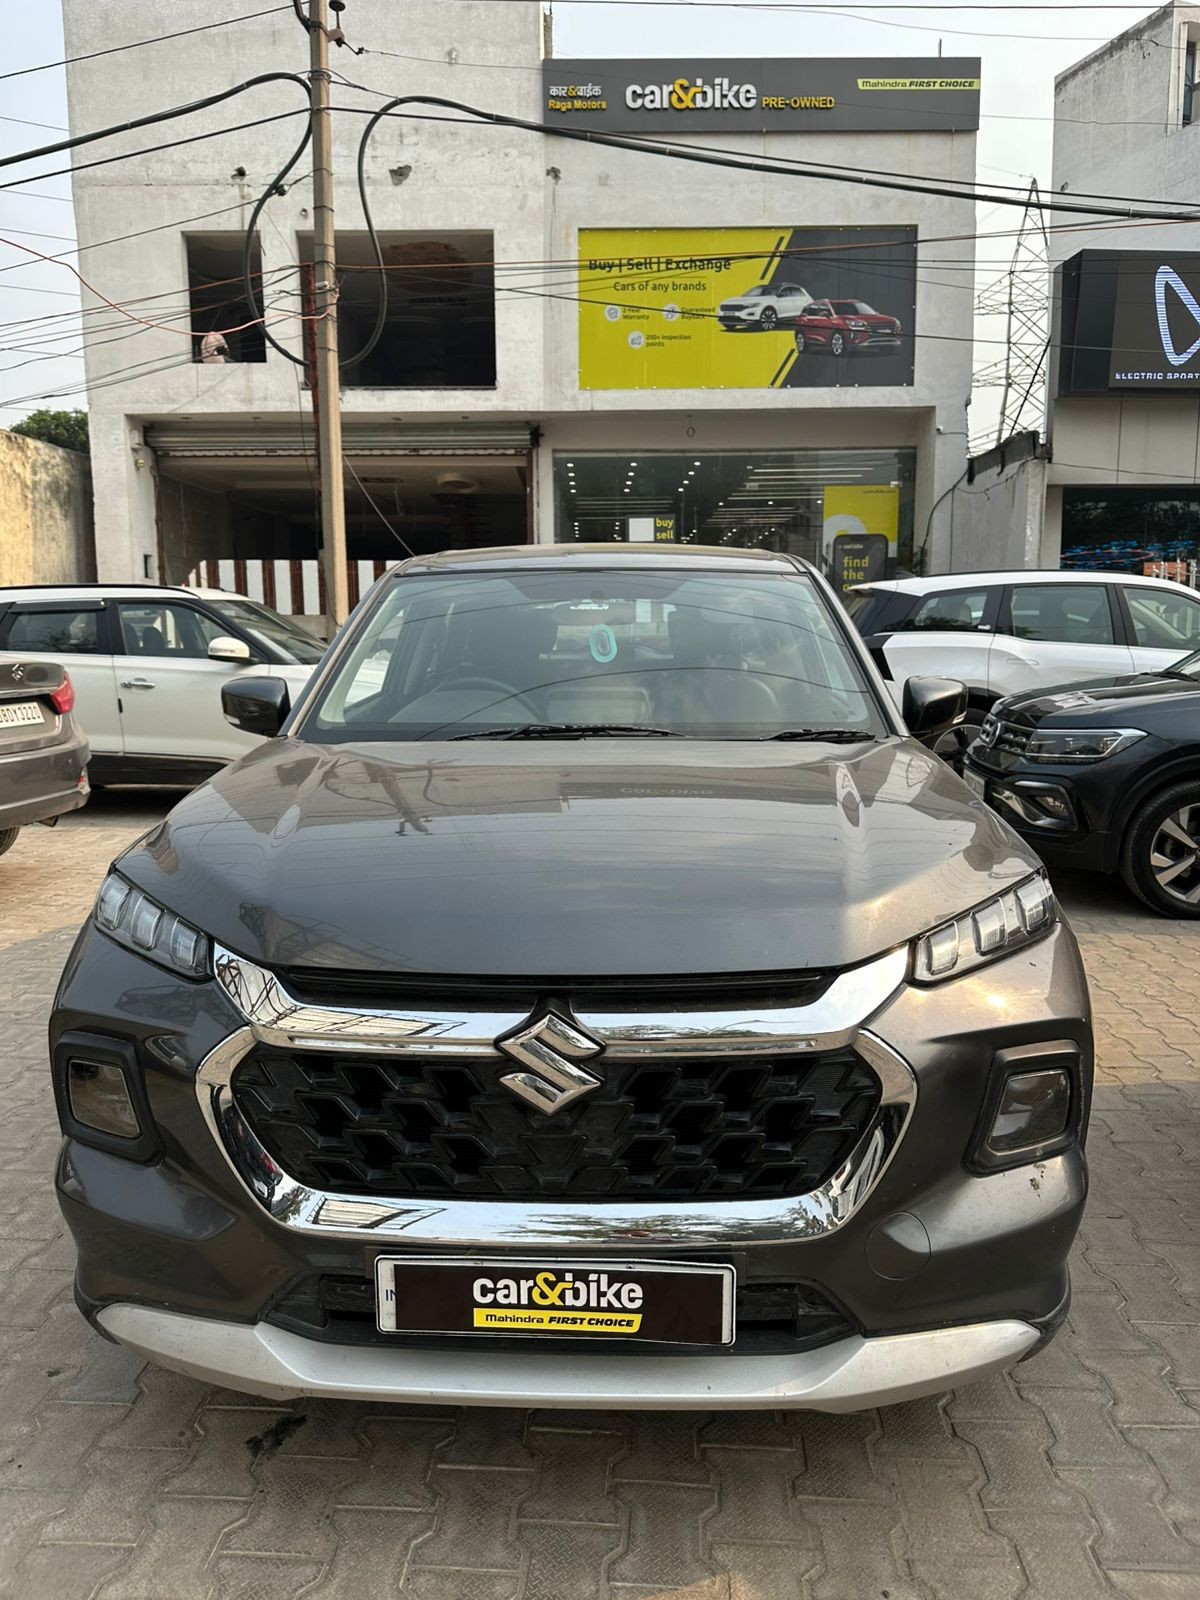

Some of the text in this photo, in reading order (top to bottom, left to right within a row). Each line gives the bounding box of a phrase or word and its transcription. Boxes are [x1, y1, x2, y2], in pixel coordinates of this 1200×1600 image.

[862, 80, 975, 88] Mahindra FIRST CHOICE
[625, 78, 757, 110] car&bike
[548, 99, 607, 111] Raga Motors
[762, 96, 836, 108] PRE-OWNED
[589, 259, 614, 272] Buy
[627, 258, 653, 270] Sell
[665, 258, 731, 272] Exchange
[613, 281, 706, 292] Cars of any brands
[1115, 372, 1163, 380] ELECTRIC
[656, 517, 673, 528] buy
[656, 530, 673, 540] sell
[843, 556, 869, 567] find
[843, 569, 864, 580] the
[473, 1271, 644, 1309] car&bike
[485, 1314, 635, 1328] Mahindra FIRST CHOICE
